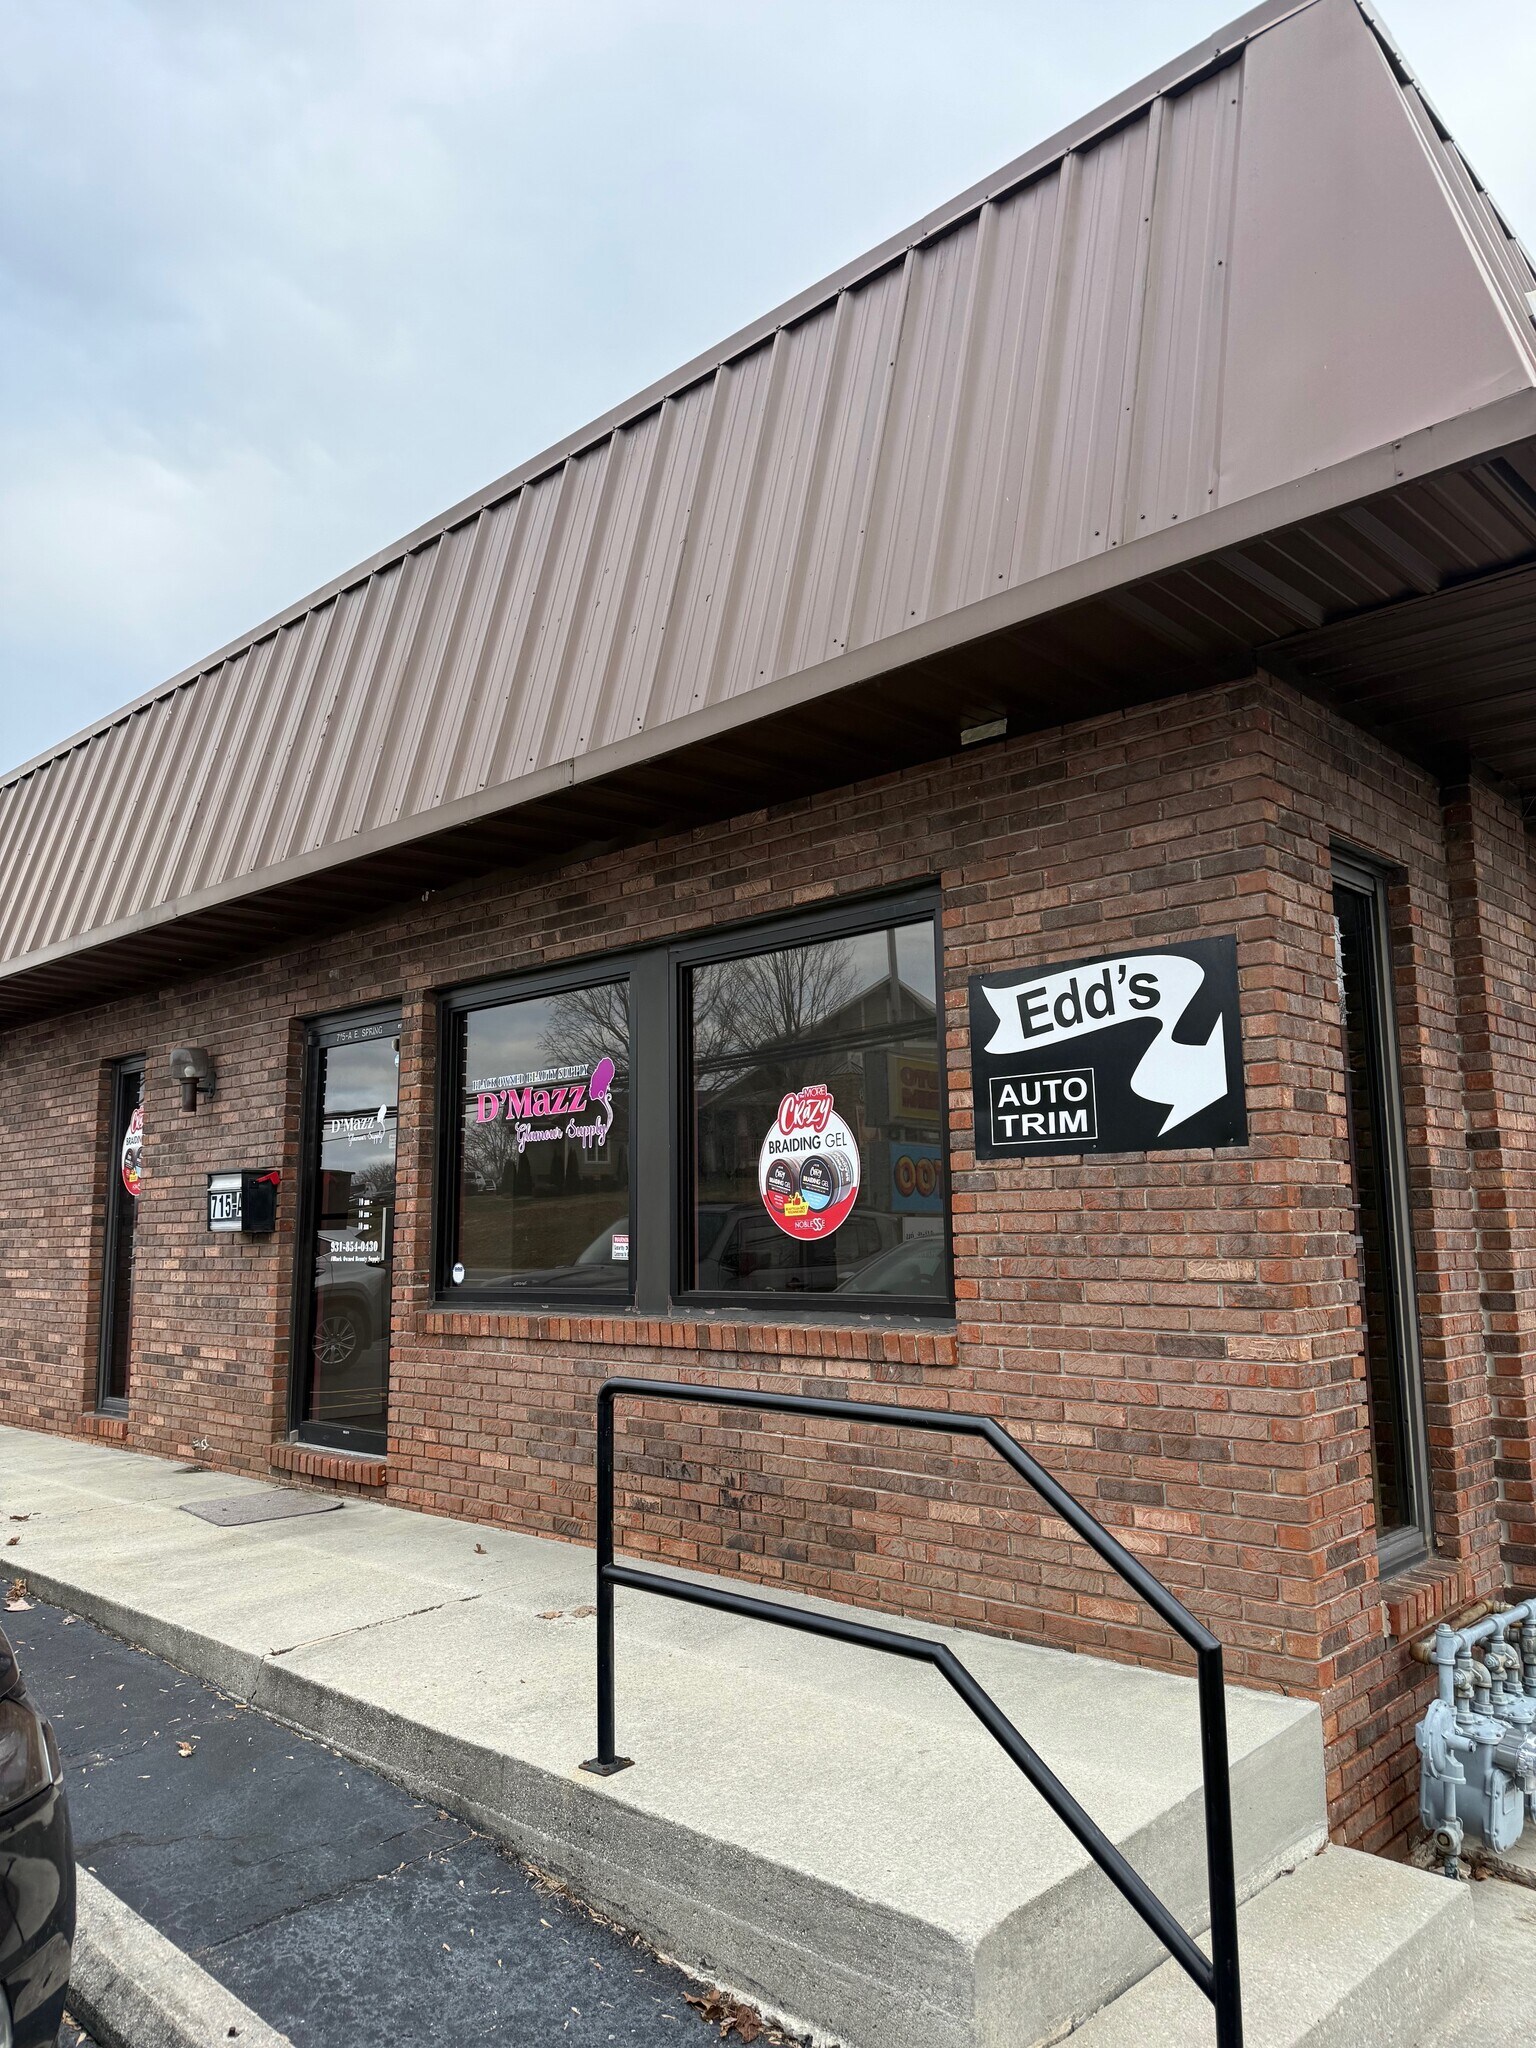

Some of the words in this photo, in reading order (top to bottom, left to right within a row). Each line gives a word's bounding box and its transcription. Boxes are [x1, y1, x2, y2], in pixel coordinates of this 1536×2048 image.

[1016, 964, 1161, 1040] Edd's
[336, 1031, 352, 1042] 715-A
[353, 1030, 359, 1039] E.
[361, 1025, 383, 1037] SPRING
[472, 1078, 498, 1090] BLACK
[497, 1073, 525, 1087] OWNED
[525, 1068, 558, 1084] BEAUTY
[557, 1064, 589, 1080] SUPPLY
[476, 1085, 587, 1123] D'Mazz
[804, 1086, 826, 1098] MORE
[997, 1077, 1088, 1108] AUTO
[331, 1117, 375, 1133] D'Mazz
[514, 1121, 563, 1154] Glamour
[566, 1115, 608, 1149] Supply
[997, 1108, 1088, 1138] TRIM
[768, 1135, 821, 1155] BRAIDING
[825, 1132, 847, 1148] GEL
[794, 1217, 826, 1232] NOBLESSE
